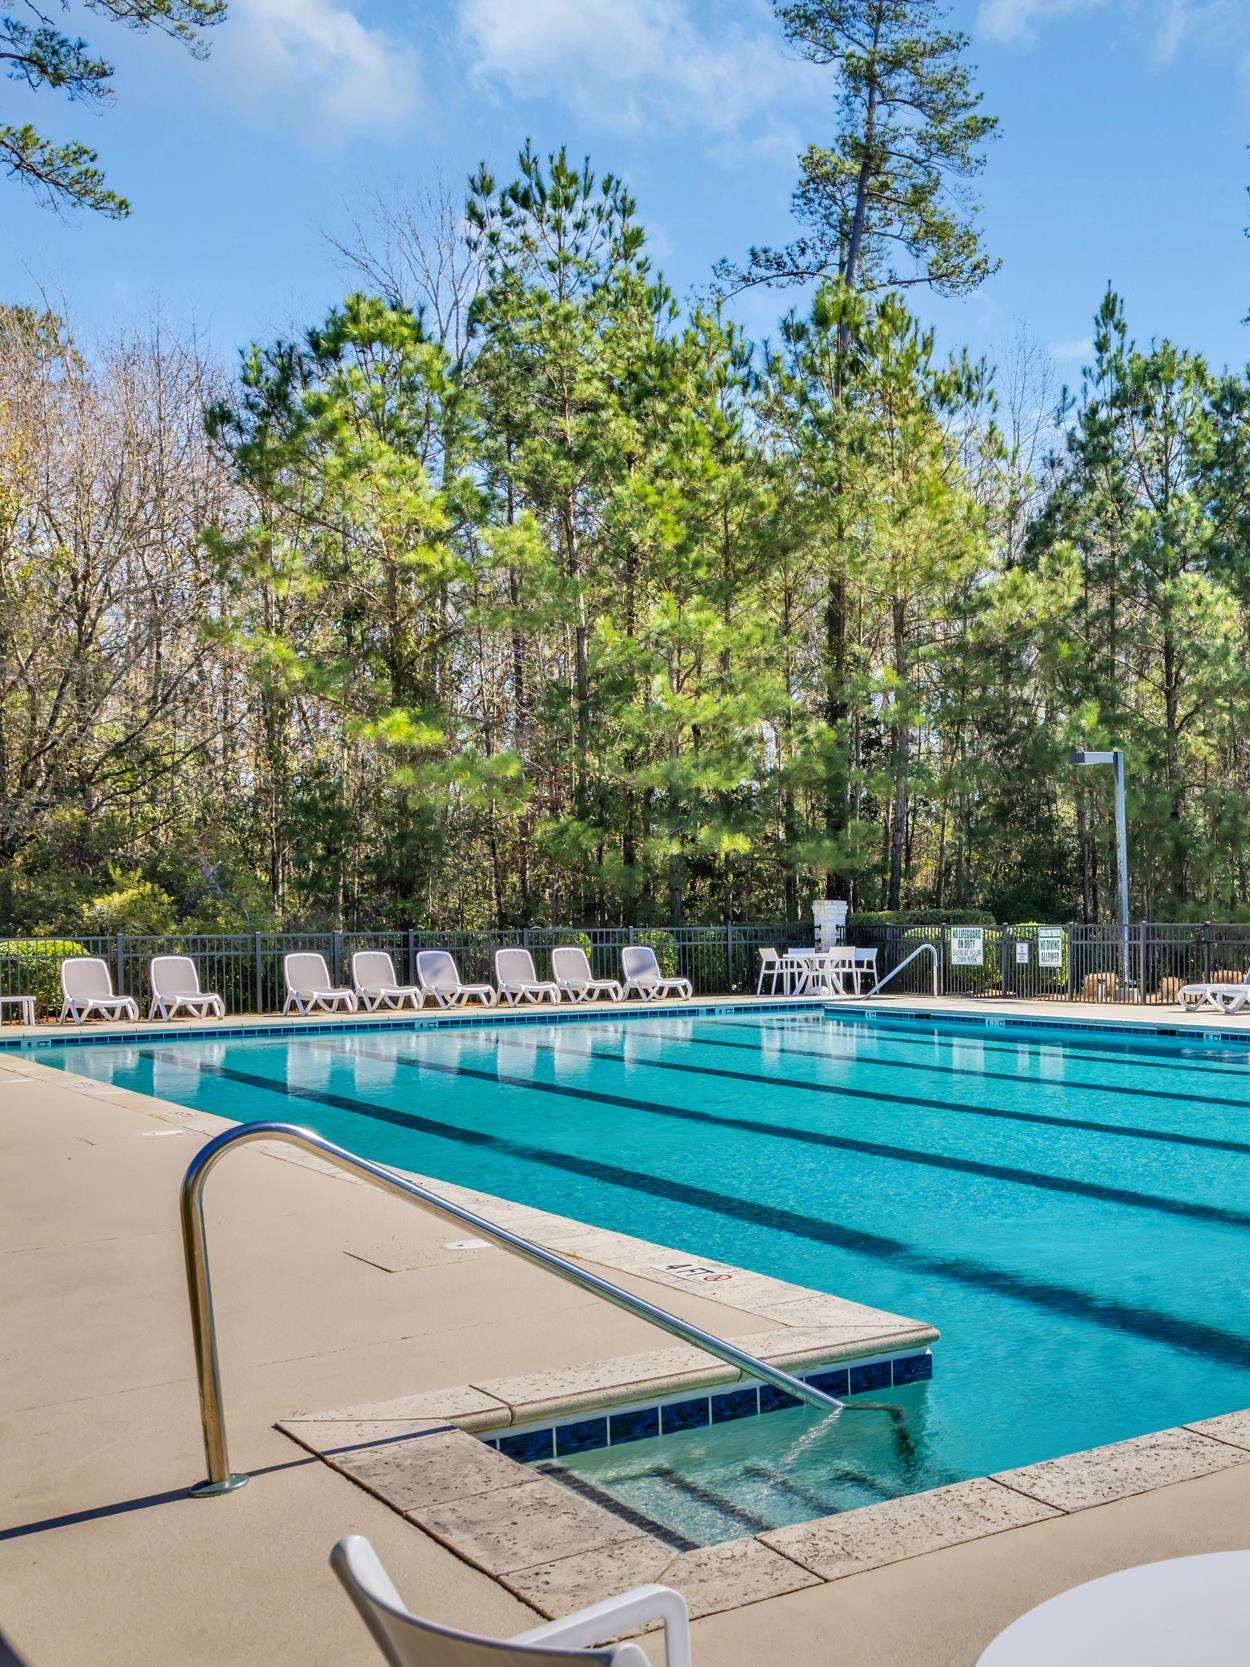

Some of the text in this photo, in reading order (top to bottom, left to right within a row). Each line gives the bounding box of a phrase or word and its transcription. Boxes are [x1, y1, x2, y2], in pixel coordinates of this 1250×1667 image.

[953, 929, 981, 939] NO LIFEGUARD
[958, 939, 975, 949] ON DUTY
[1040, 940, 1060, 950] NO DIVING
[1041, 952, 1060, 962] ALLOWED
[675, 1266, 716, 1277] FT
